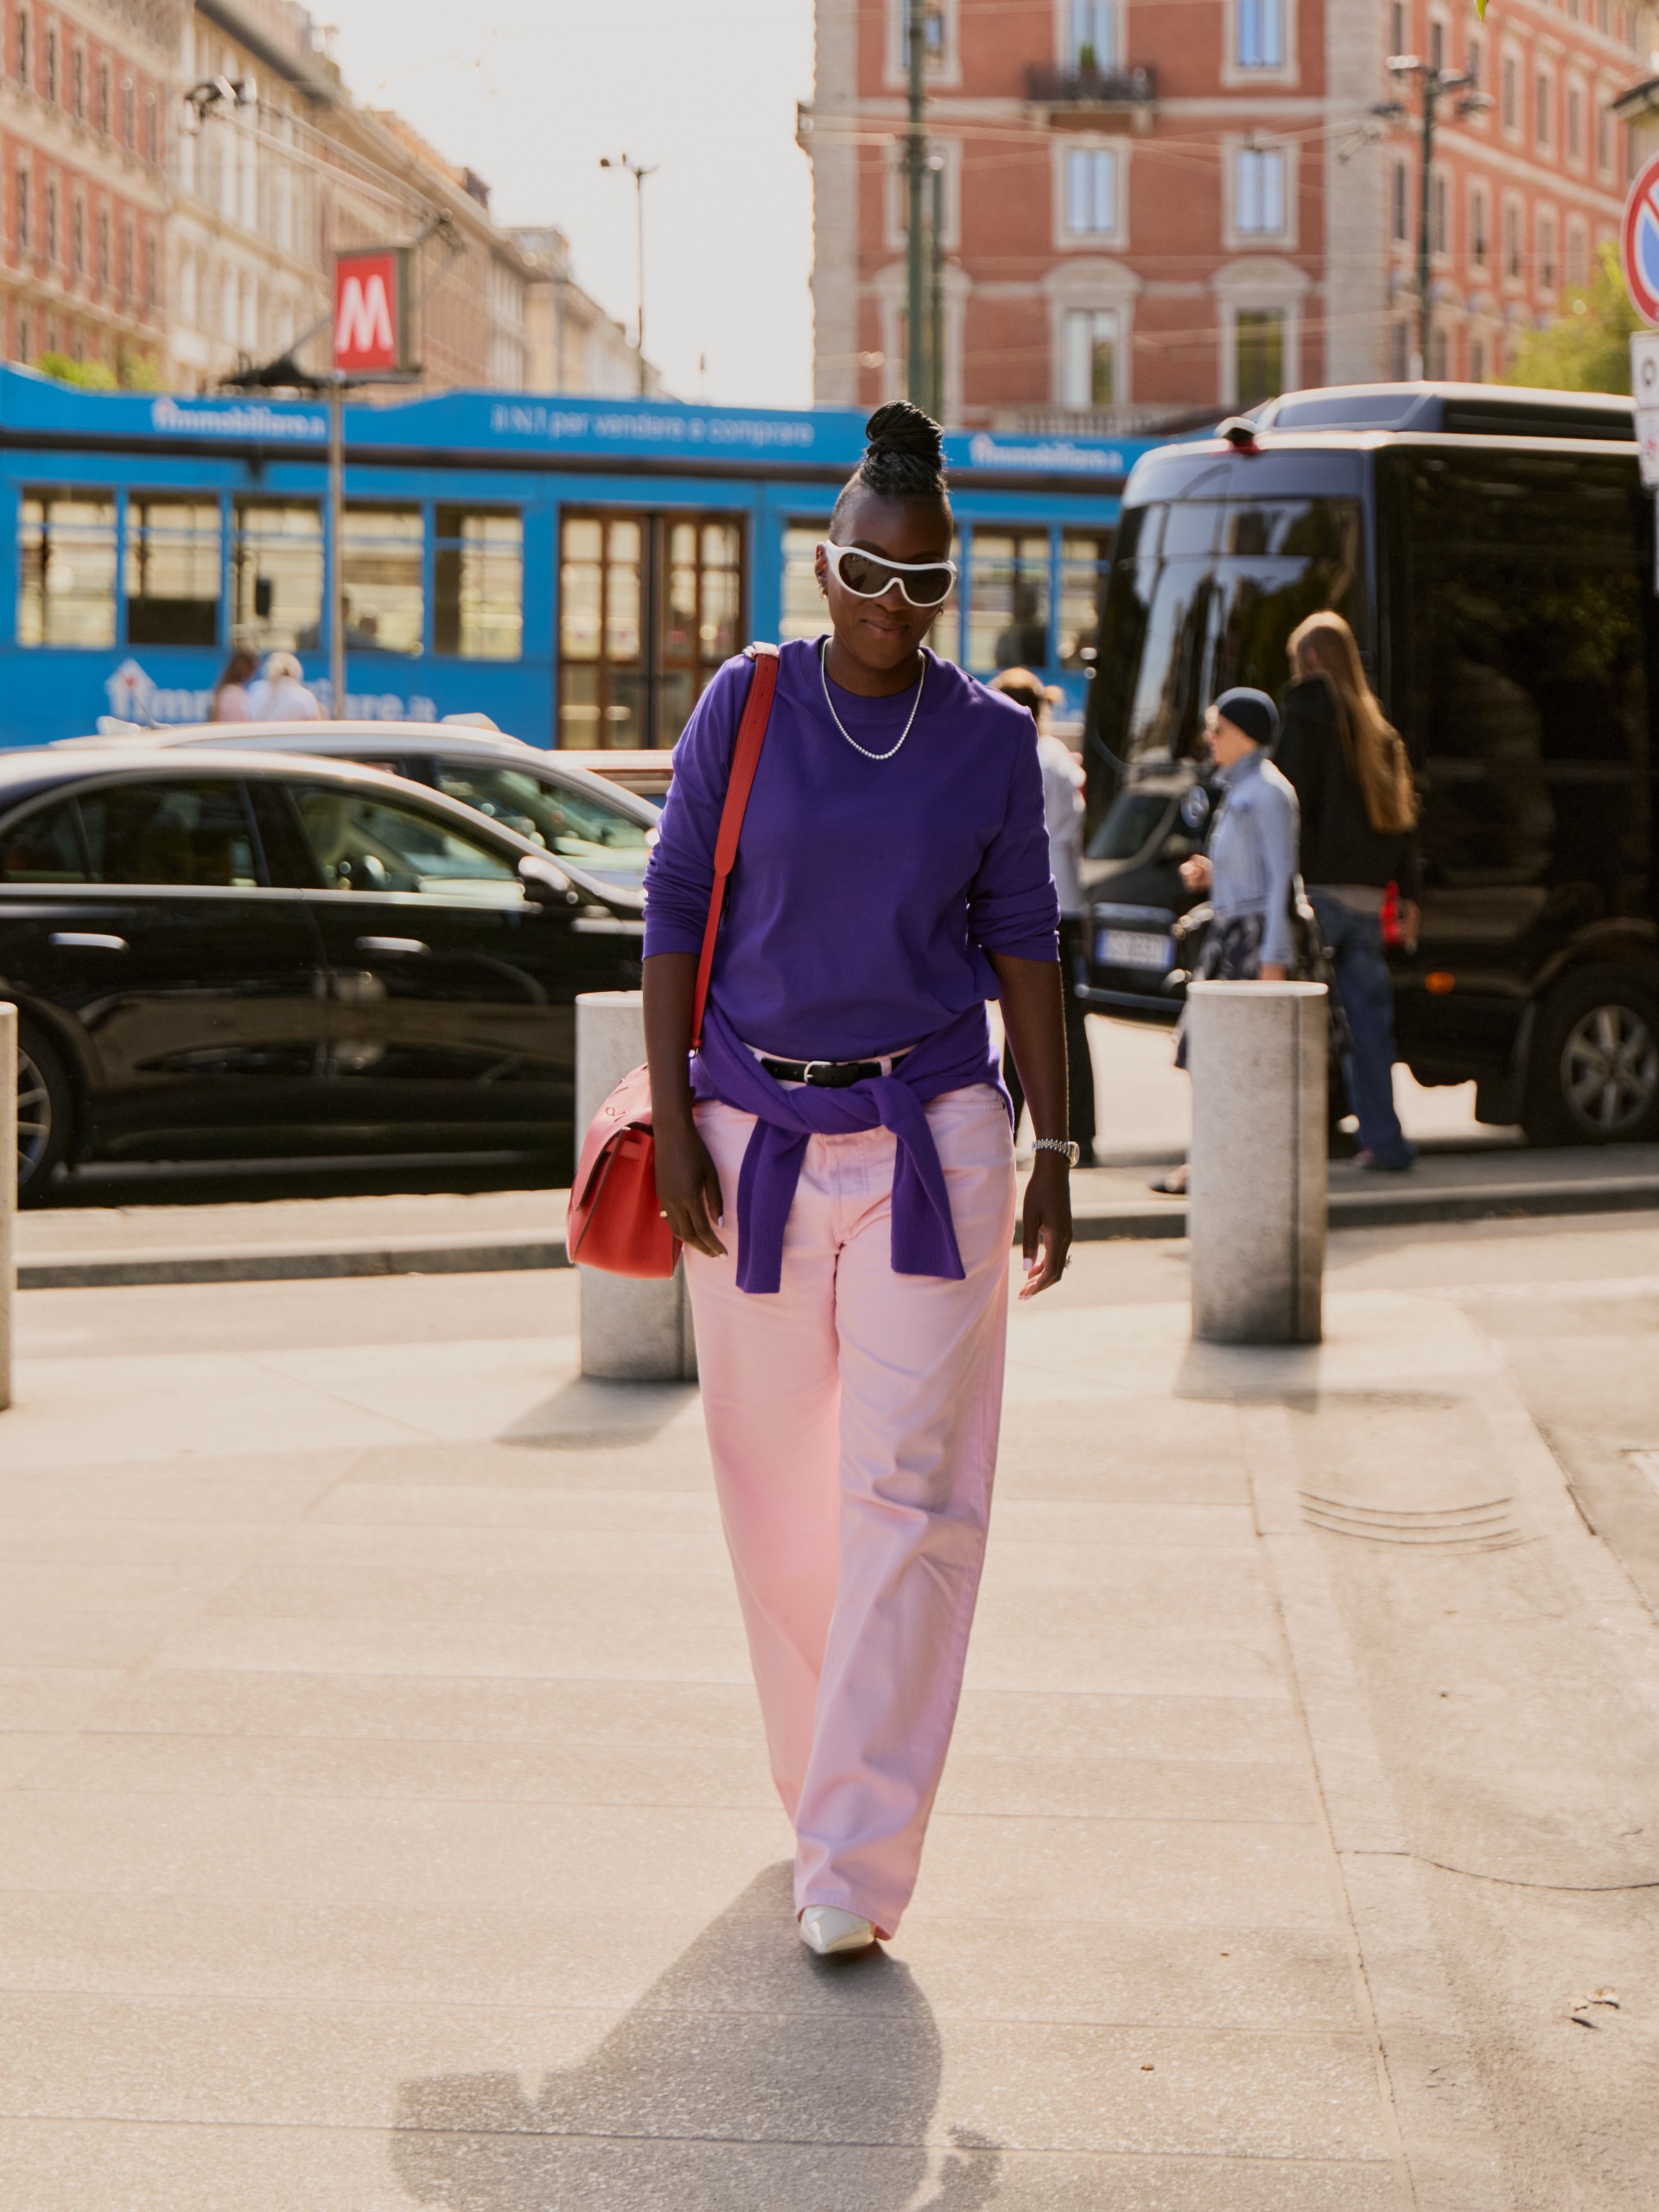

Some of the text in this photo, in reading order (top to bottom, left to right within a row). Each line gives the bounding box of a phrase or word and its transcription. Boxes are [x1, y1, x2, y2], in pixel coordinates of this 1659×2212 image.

[335, 276, 394, 353] M
[548, 410, 588, 440] per
[592, 411, 686, 442] vendere
[707, 418, 815, 448] comprare
